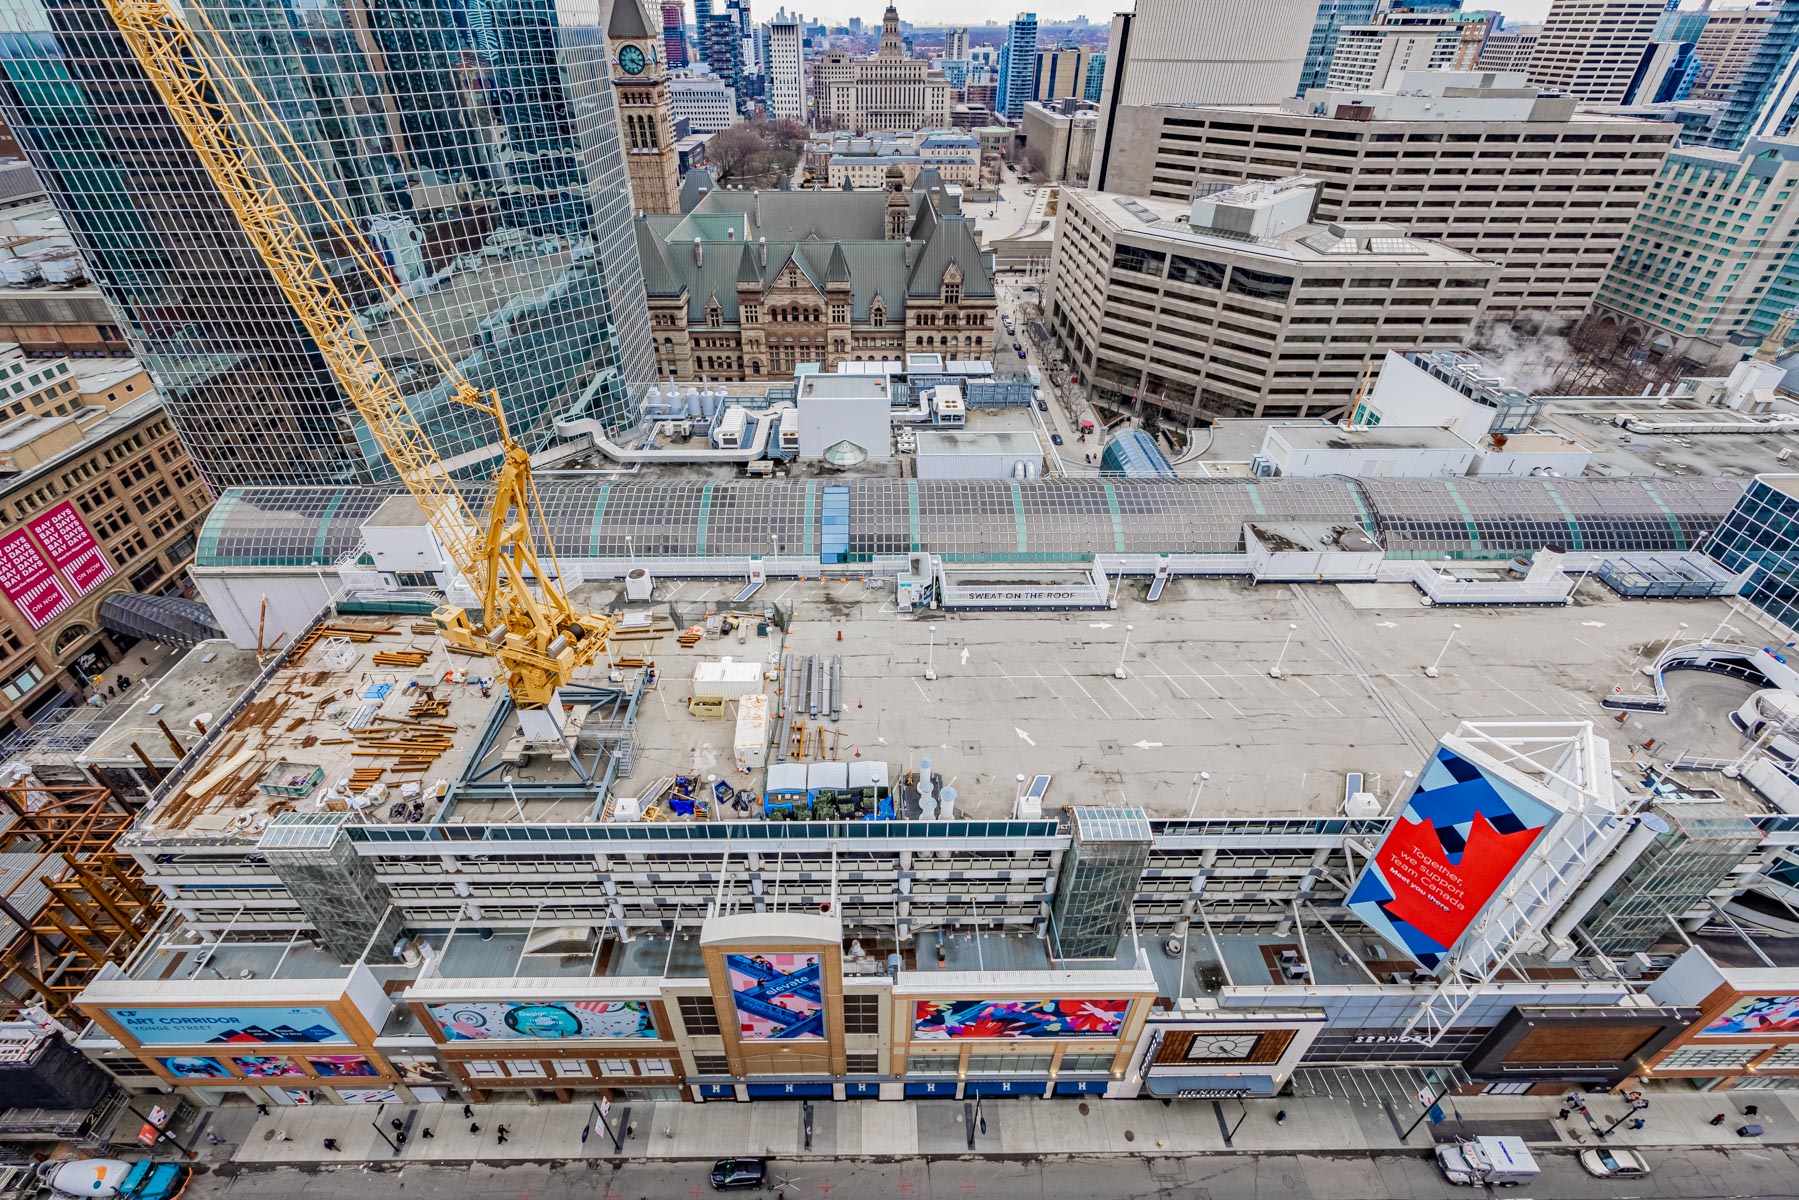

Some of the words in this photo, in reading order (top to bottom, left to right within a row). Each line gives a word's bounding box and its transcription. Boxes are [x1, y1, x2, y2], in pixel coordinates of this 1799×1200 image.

[35, 520, 51, 534] BAY
[51, 508, 72, 523] DAYS
[39, 526, 55, 540] BAY
[55, 514, 76, 529] DAYS
[43, 532, 59, 546] BAY
[59, 520, 80, 535] DAYS
[47, 538, 63, 551] BAY
[63, 526, 84, 541] DAYS
[3, 536, 26, 553] DAYS
[8, 542, 31, 559] DAYS
[51, 544, 67, 557] BAY
[67, 532, 88, 547] DAYS
[0, 562, 12, 576] AY
[13, 548, 35, 565] DAYS
[17, 554, 39, 571] DAYS
[77, 572, 87, 581] ON
[86, 562, 101, 575] NOW
[3, 574, 21, 588] BAY
[22, 560, 44, 577] DAYS
[32, 602, 43, 613] ON
[43, 592, 59, 606] NOW
[968, 592, 1004, 600] SWEAT
[1005, 592, 1023, 600] ON
[1025, 592, 1045, 600] THE
[1390, 853, 1418, 878] Team
[1420, 876, 1465, 911] Canada
[1401, 851, 1418, 866] we
[1419, 865, 1465, 898] support
[1389, 866, 1410, 884] Meet
[1410, 882, 1427, 896] you
[1427, 893, 1450, 912] there
[765, 976, 809, 996] elevate
[127, 1017, 154, 1025] ART
[712, 1084, 721, 1093] H
[785, 1084, 794, 1092] H
[858, 1083, 866, 1092] H
[927, 1083, 935, 1092] H
[1002, 1083, 1011, 1091] H
[1078, 1082, 1086, 1090] H
[86, 1113, 99, 1126] 2
